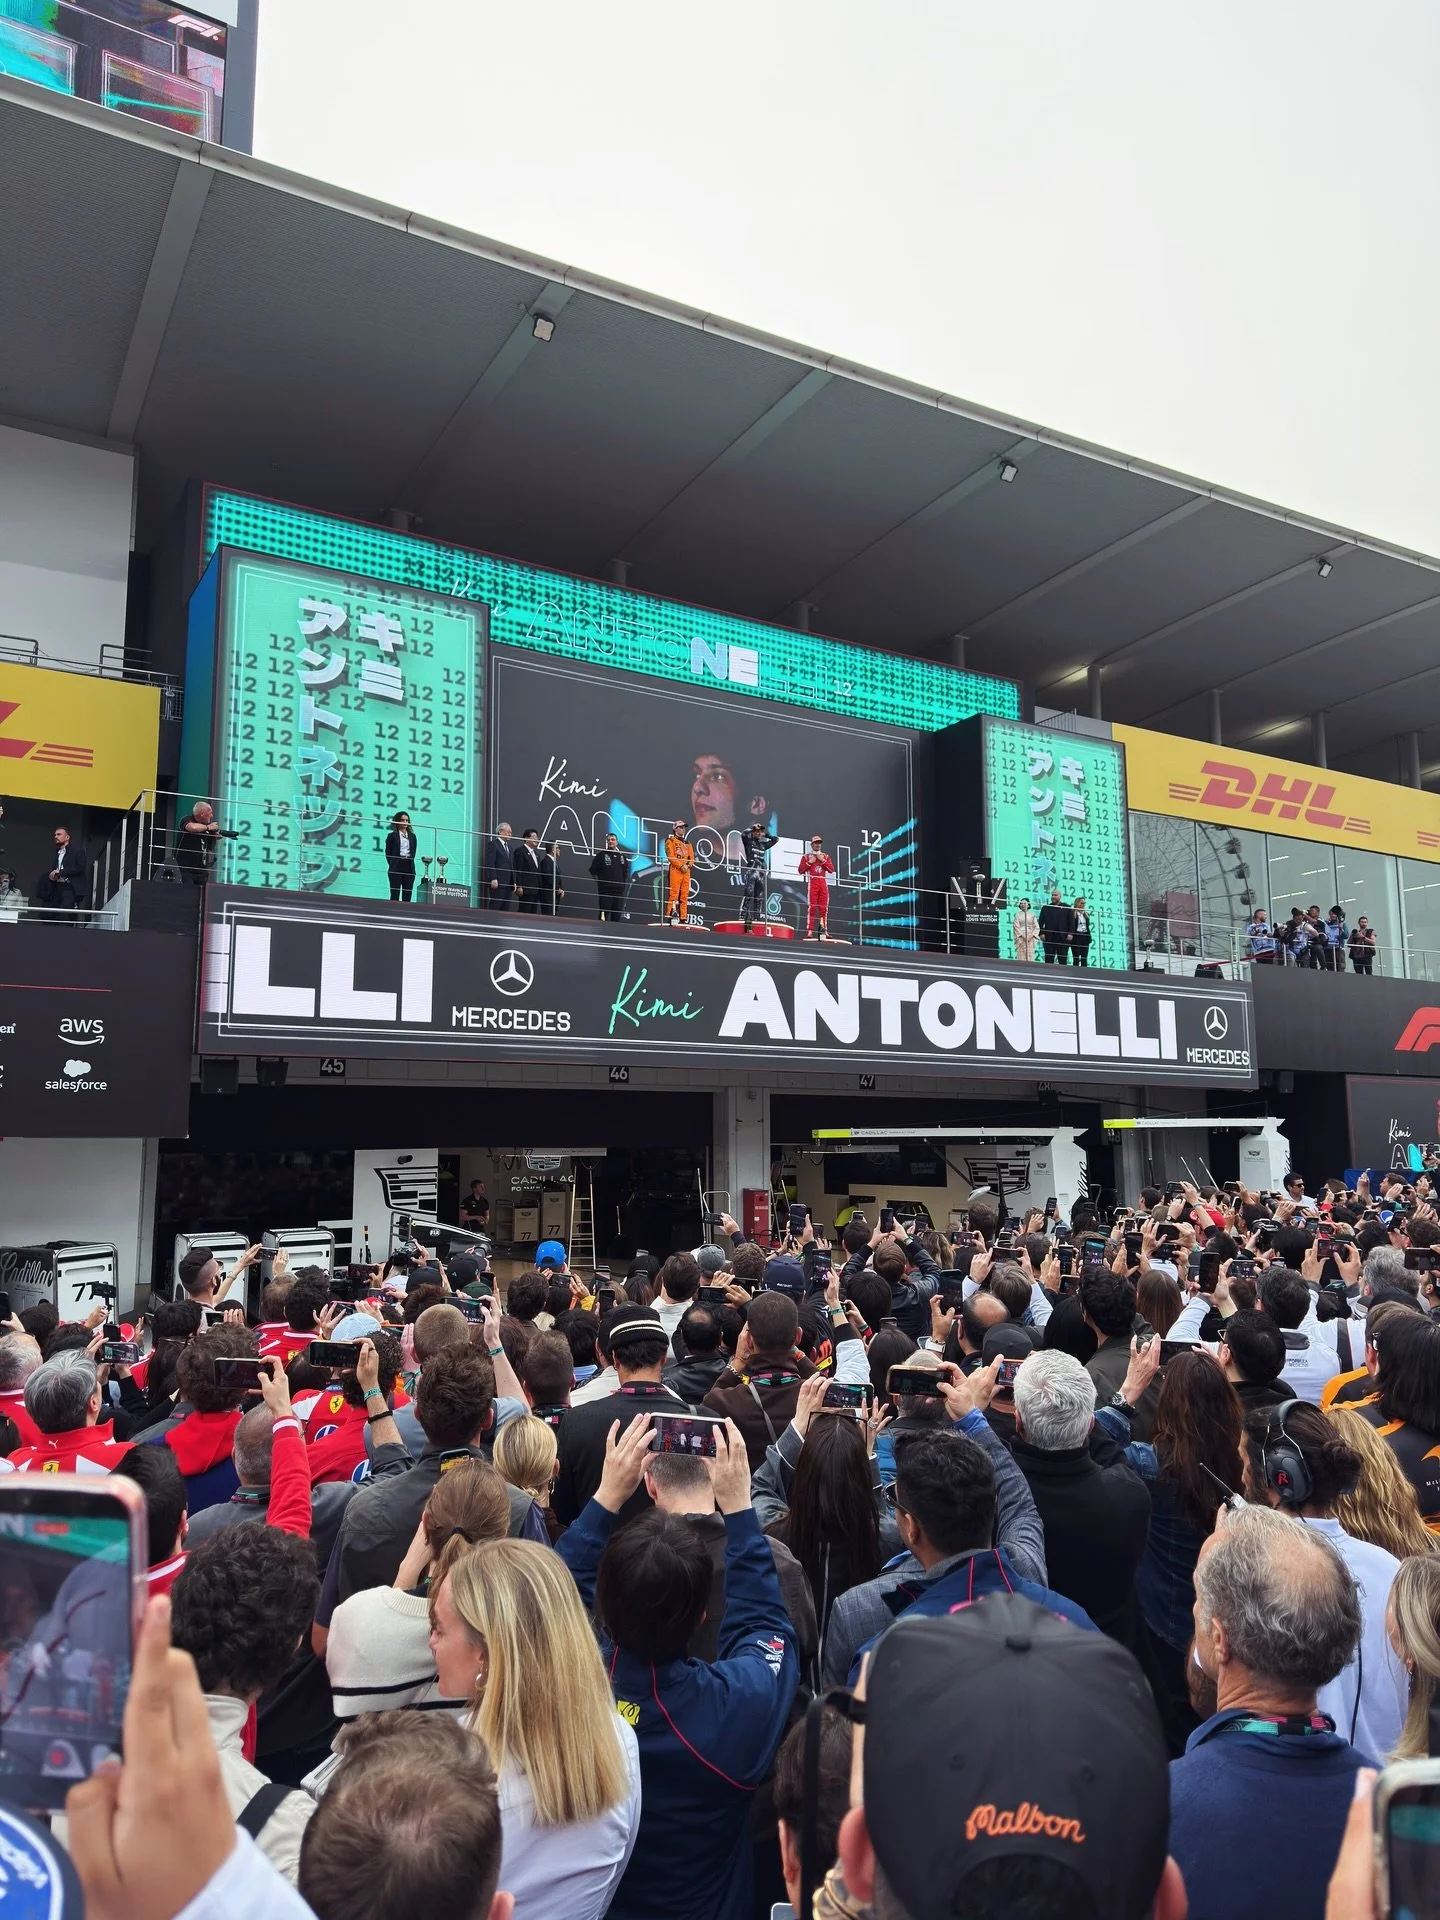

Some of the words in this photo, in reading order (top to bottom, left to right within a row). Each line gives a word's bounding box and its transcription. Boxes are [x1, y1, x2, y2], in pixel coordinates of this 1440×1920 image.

[411, 617, 434, 636] 12
[269, 633, 295, 652] 12
[410, 640, 434, 658] 12
[526, 601, 828, 702] ANTONELLI
[834, 680, 852, 697] 12
[357, 611, 405, 703] キミ
[268, 657, 294, 676] 12
[443, 668, 466, 686] 12
[268, 680, 294, 699] 12
[410, 683, 433, 702] 12
[442, 690, 466, 708] 12
[340, 694, 366, 712] 12
[266, 704, 293, 723] 12
[410, 706, 433, 724] 12
[442, 712, 465, 730] 12
[266, 728, 292, 746] 12
[375, 722, 400, 740] 12
[409, 728, 432, 746] 12
[442, 734, 465, 751] 12
[340, 739, 364, 758] 12
[374, 745, 399, 763] 12
[408, 750, 432, 768] 12
[442, 756, 464, 774] 12
[1002, 741, 1016, 754] 12
[266, 752, 292, 770] 12
[1002, 758, 1016, 771] 12
[1094, 760, 1106, 772] 12
[374, 768, 398, 786] 12
[408, 773, 432, 790] 12
[441, 778, 464, 796] 12
[538, 755, 608, 801] Kimi
[1002, 775, 1016, 788] 12
[1094, 775, 1108, 788] 12
[1060, 756, 1085, 820] キミ
[1200, 760, 1346, 829] DHL
[374, 790, 398, 808] 12
[408, 796, 432, 813] 12
[1003, 791, 1017, 805] 12
[1095, 791, 1108, 804] 12
[1096, 808, 1108, 820] 12
[262, 823, 289, 842] 12
[861, 829, 882, 848] 12
[1096, 824, 1109, 836] 12
[337, 832, 362, 850] 12
[1061, 835, 1074, 848] 12
[1079, 838, 1092, 850] 12
[1097, 841, 1110, 853] 12
[262, 847, 288, 865] 12
[336, 855, 362, 873] 12
[1062, 852, 1075, 864] 12
[1080, 854, 1093, 867] 12
[1098, 857, 1110, 870] 12
[1004, 861, 1018, 874] 12
[260, 872, 288, 889] 12
[1062, 868, 1076, 881] 12
[1080, 871, 1094, 884] 12
[1098, 874, 1111, 886] 12
[1062, 885, 1076, 898] 12
[1099, 890, 1112, 903] 12
[766, 927, 773, 937] 1
[452, 1005, 571, 1032] MERCEDES
[608, 965, 704, 1034] Kimi
[718, 965, 1178, 1060] ANTONELLI
[60, 1018, 104, 1033] aws
[1187, 1047, 1250, 1066] MERCEDES
[321, 1058, 345, 1075] 45
[610, 1066, 628, 1080] 46
[44, 1078, 108, 1093] salesforce
[860, 1075, 874, 1087] 47
[1389, 1118, 1411, 1144] Kimi
[521, 1232, 532, 1240] 77
[548, 1225, 561, 1235] 77
[0, 1251, 54, 1288] Cadillac
[1277, 1472, 1289, 1485] R
[966, 1801, 1086, 1843] Malbon
